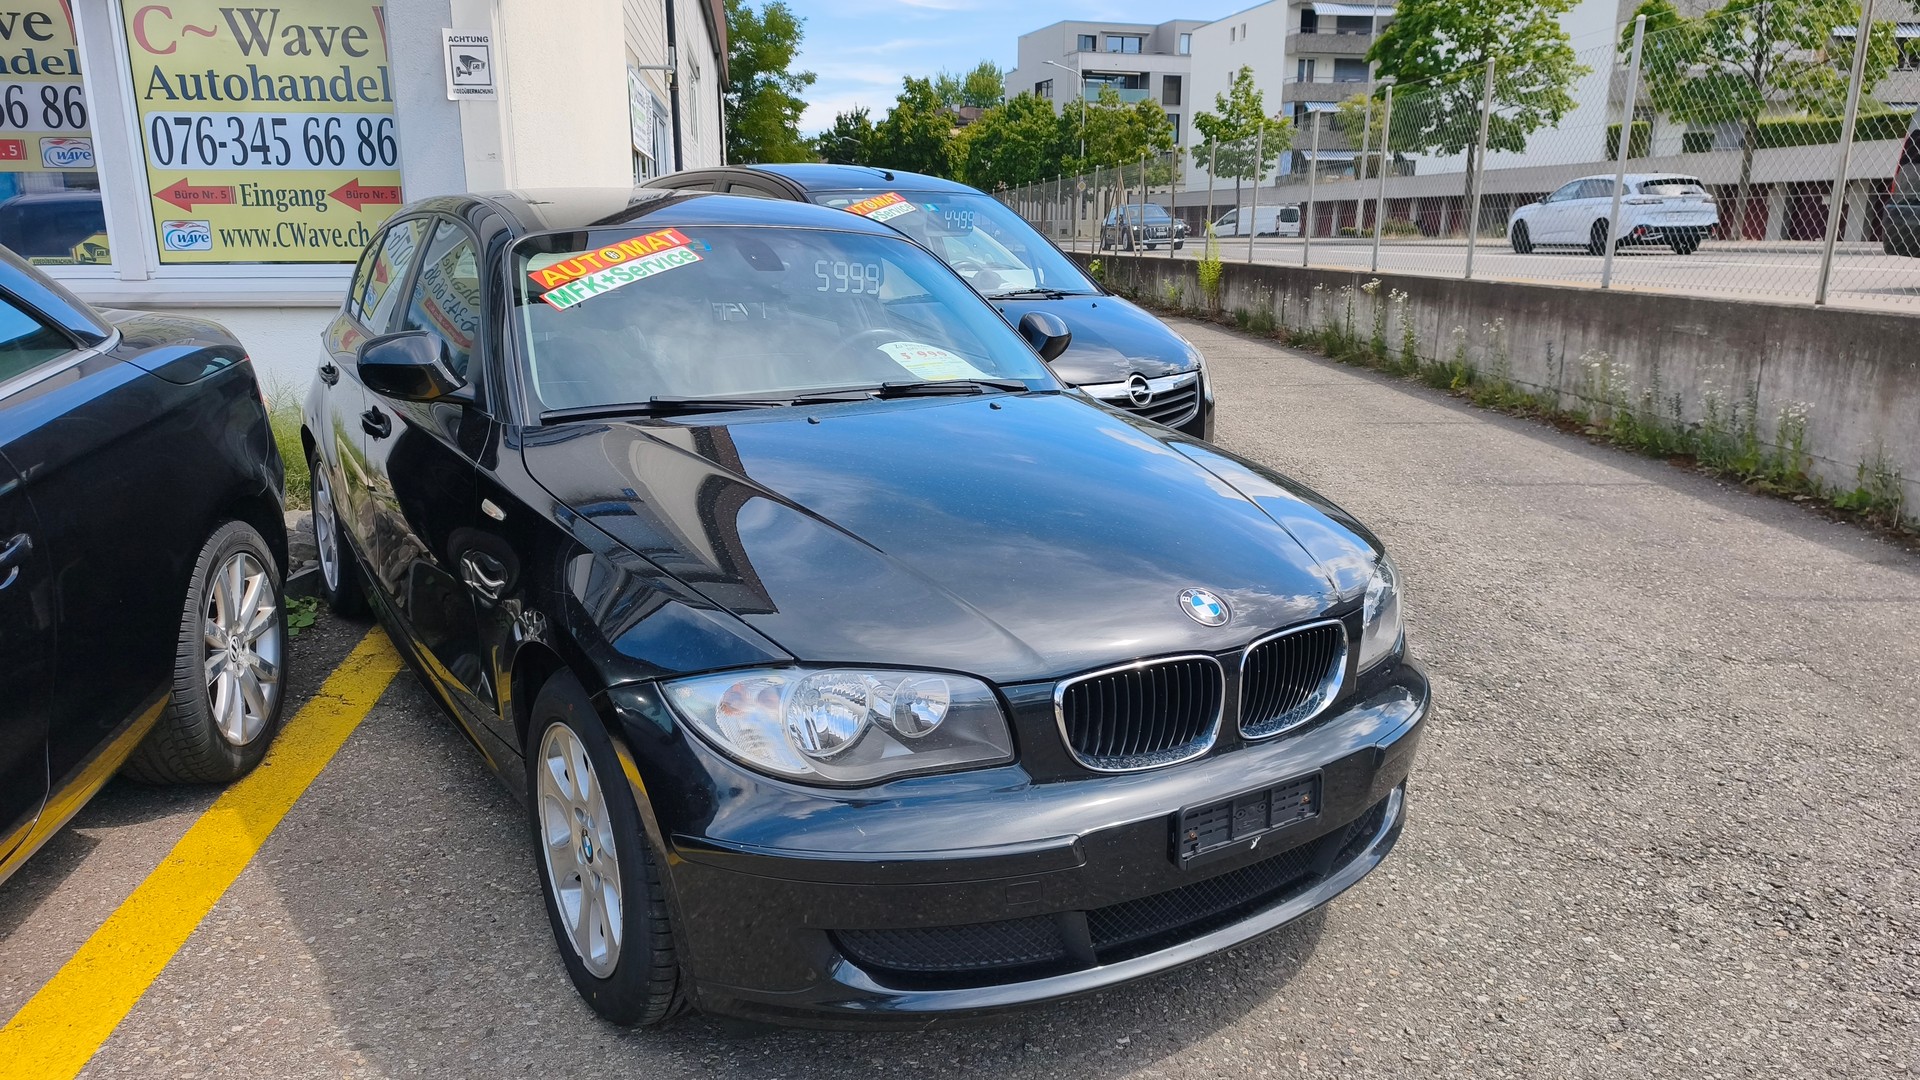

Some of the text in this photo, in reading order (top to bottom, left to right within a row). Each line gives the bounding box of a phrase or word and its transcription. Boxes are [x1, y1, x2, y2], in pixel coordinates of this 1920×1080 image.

[447, 35, 489, 43] ACHTUNG
[143, 64, 394, 103] Autohandel
[0, 84, 87, 129] 6 86
[151, 115, 398, 167] 076-345 66 86
[174, 188, 228, 201] Büro Nr. 5
[239, 182, 328, 213] Eingang
[345, 188, 397, 201] Büro Nr. 5
[219, 221, 370, 249] www.CWave.ch
[541, 229, 681, 286] AUTOMAT
